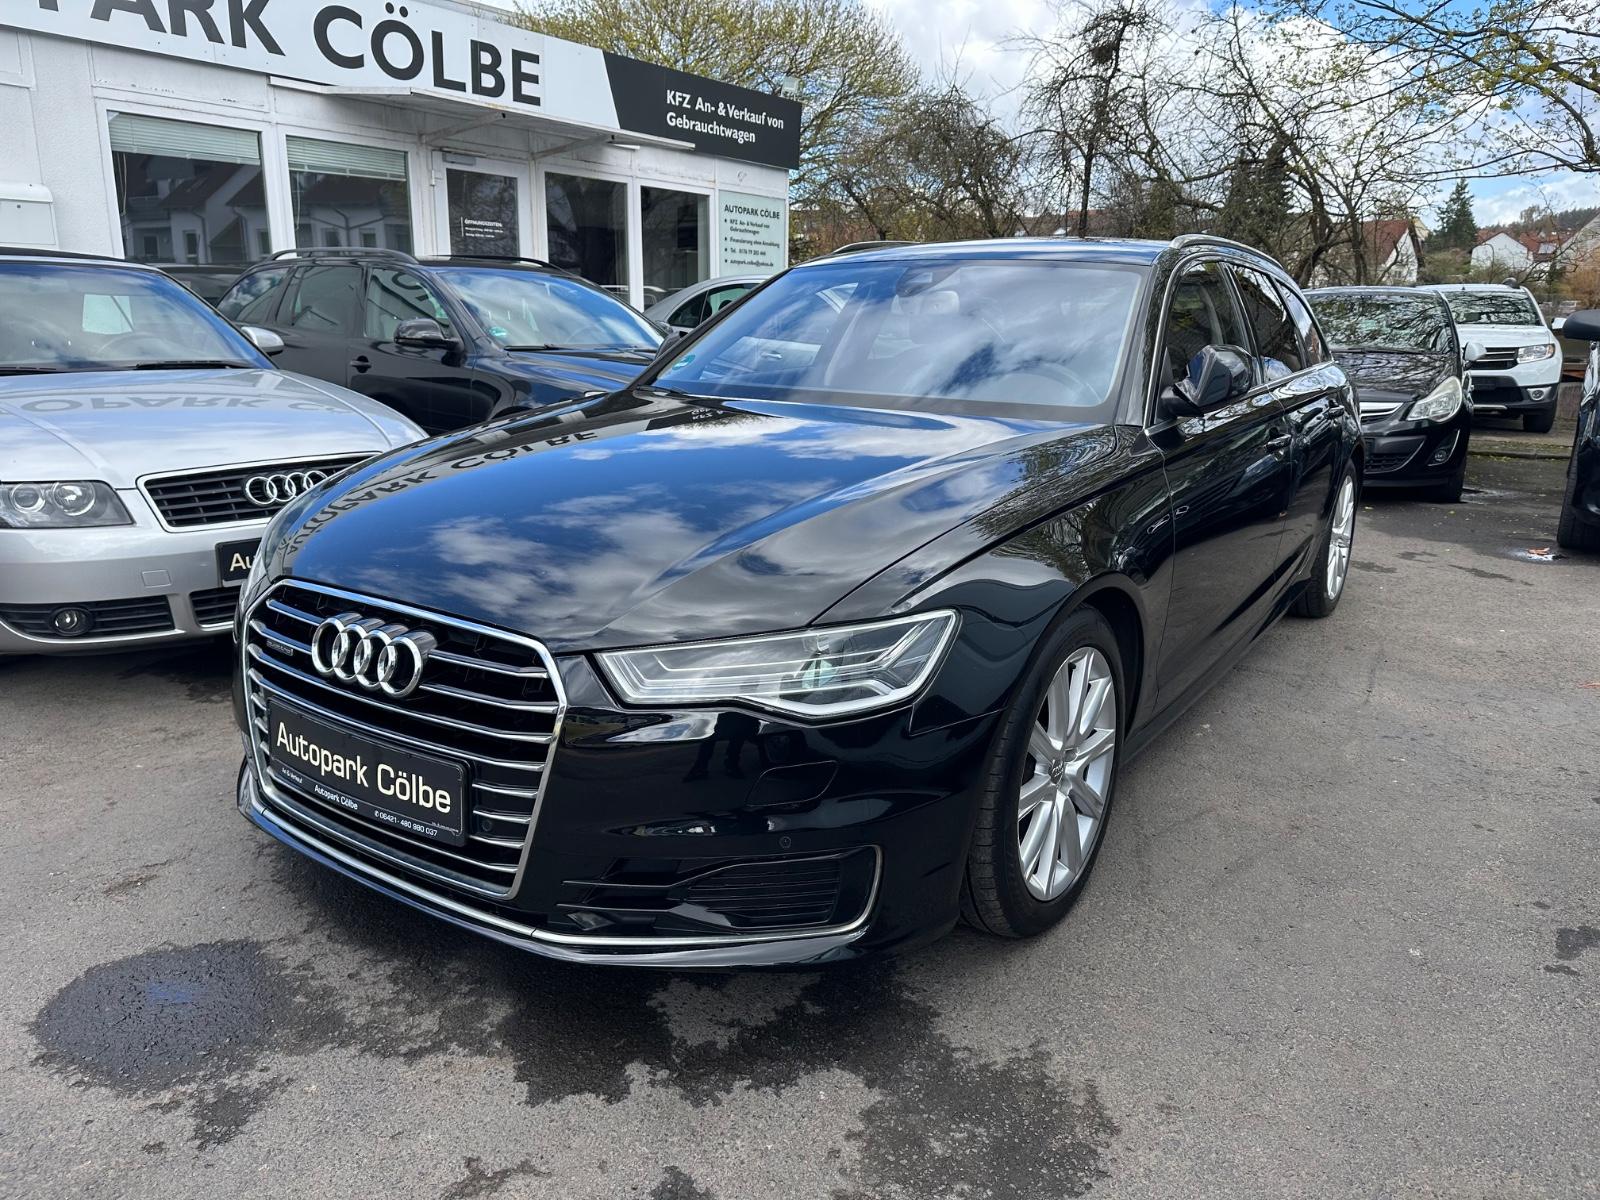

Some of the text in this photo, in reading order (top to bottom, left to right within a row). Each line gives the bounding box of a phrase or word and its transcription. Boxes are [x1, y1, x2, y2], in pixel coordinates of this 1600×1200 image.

[39, 0, 541, 106] RK CÖLBE
[666, 89, 784, 129] KFZ An- & Verkauf von
[666, 112, 756, 144] Gebrauchtwagen
[724, 204, 780, 219] AUTOPARK CÖLBE
[276, 722, 451, 814] Autopark Cölbe
[314, 784, 358, 810] Autopark Cölbe
[380, 812, 397, 824] 06421
[400, 819, 412, 829] 480
[412, 823, 425, 832] 980
[425, 827, 438, 837] 037
